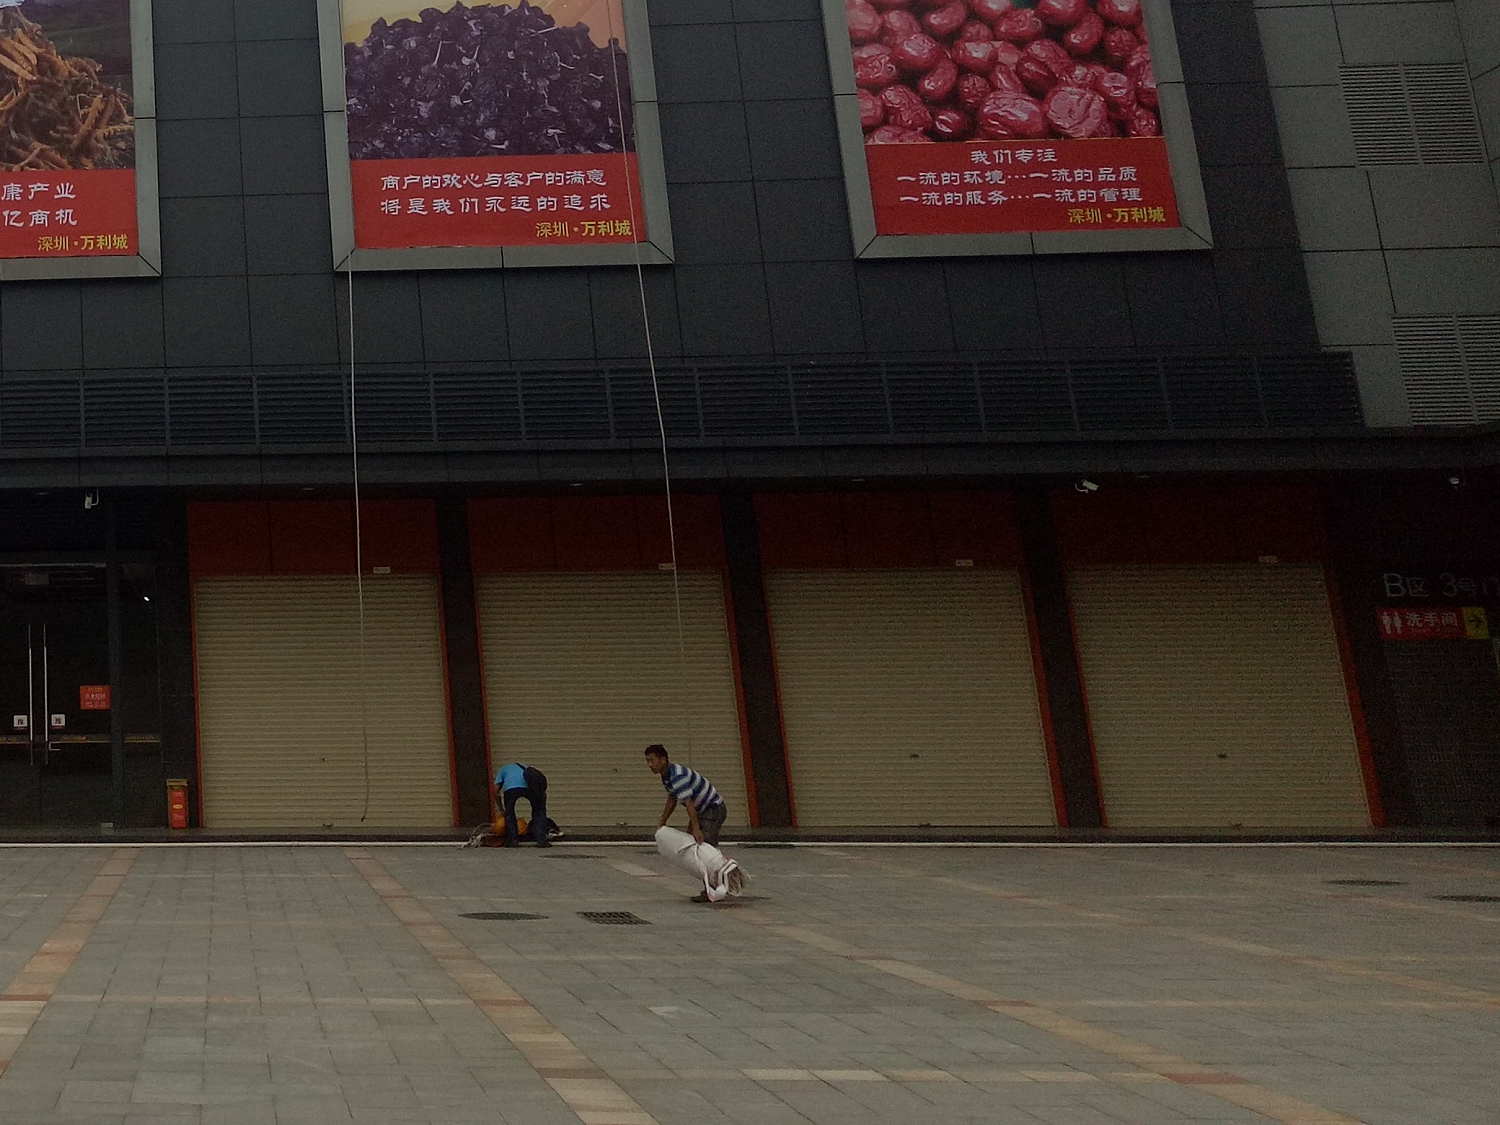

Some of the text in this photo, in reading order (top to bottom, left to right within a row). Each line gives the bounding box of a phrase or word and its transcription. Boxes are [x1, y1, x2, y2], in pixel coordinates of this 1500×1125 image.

[970, 148, 1058, 165] 我们专注
[381, 169, 607, 191] 商户的欢心与客户的满意
[381, 193, 611, 215] 将是我们永远的追求
[1406, 611, 1458, 627] 洗手间
